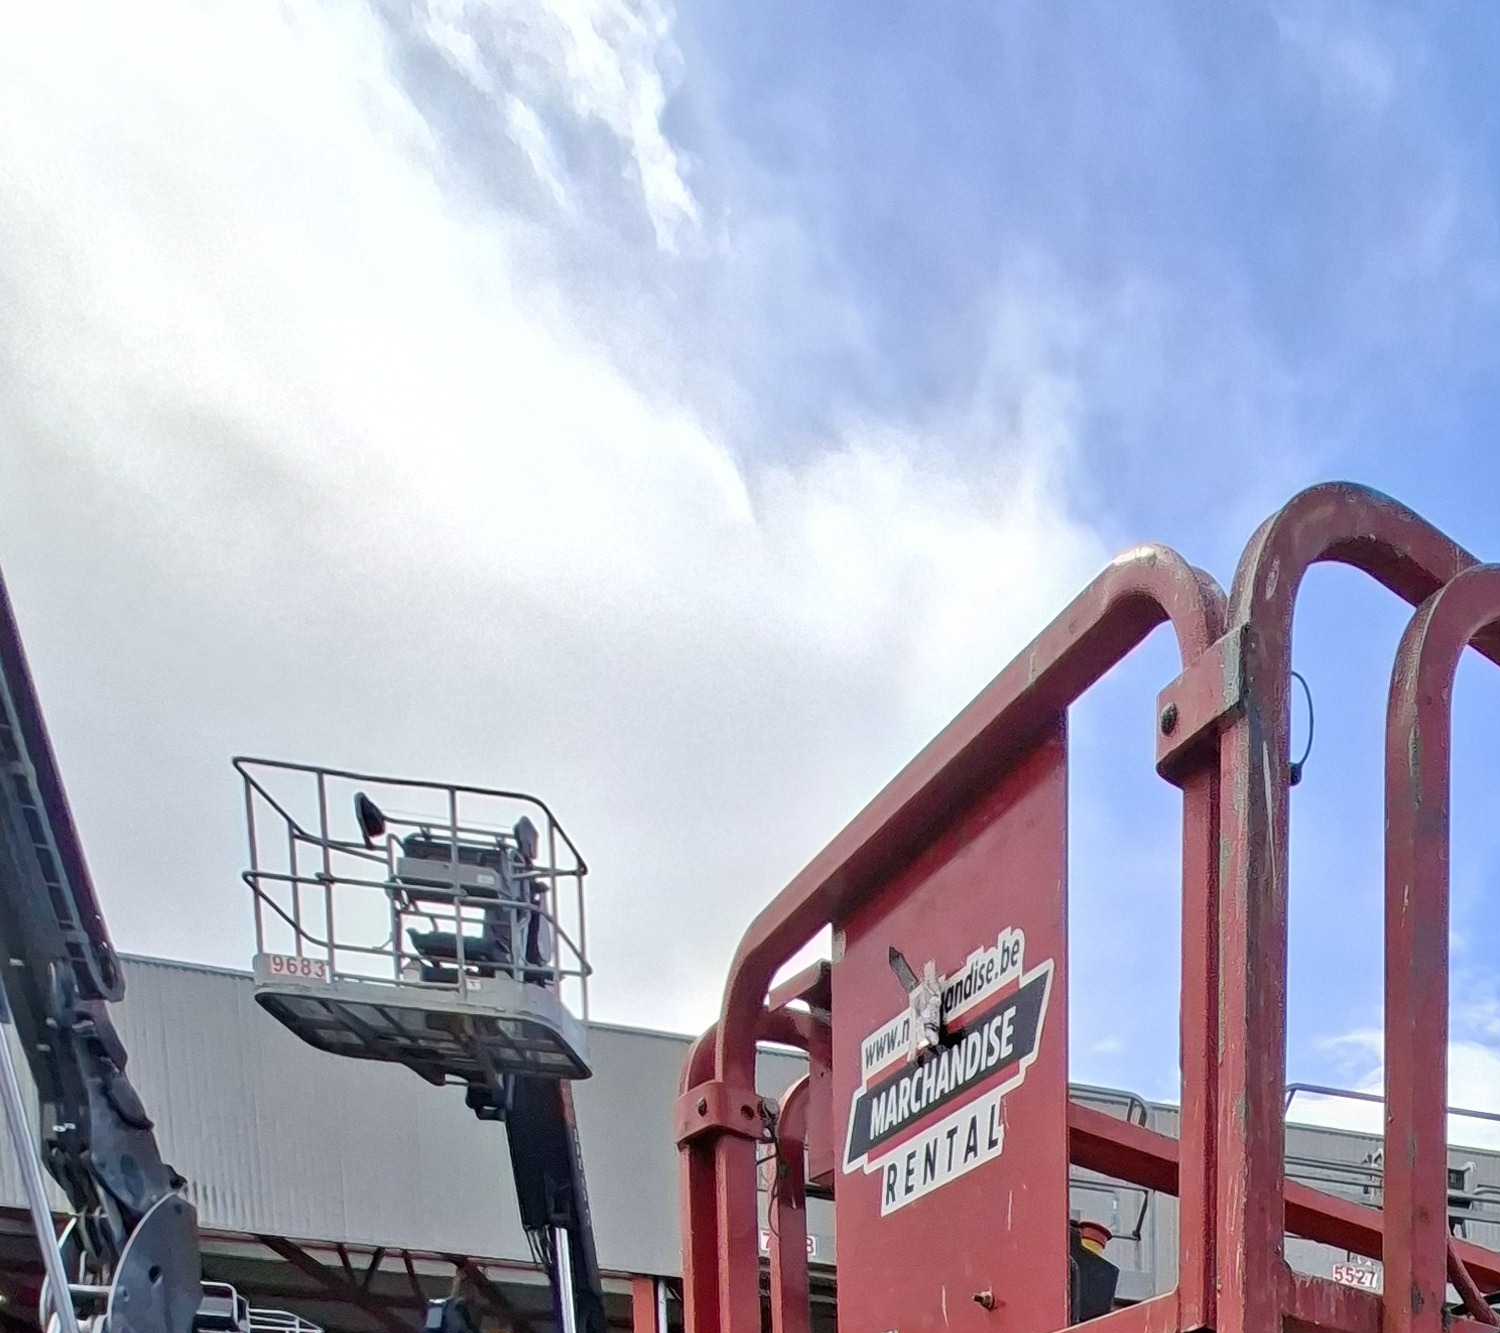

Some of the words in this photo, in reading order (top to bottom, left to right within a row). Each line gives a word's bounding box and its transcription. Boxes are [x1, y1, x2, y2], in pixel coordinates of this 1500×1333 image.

[271, 955, 326, 978] 9683
[869, 1004, 1018, 1141] MARCHANDISE
[885, 1103, 1000, 1206] RENTAL
[1334, 1264, 1377, 1286] 5527
